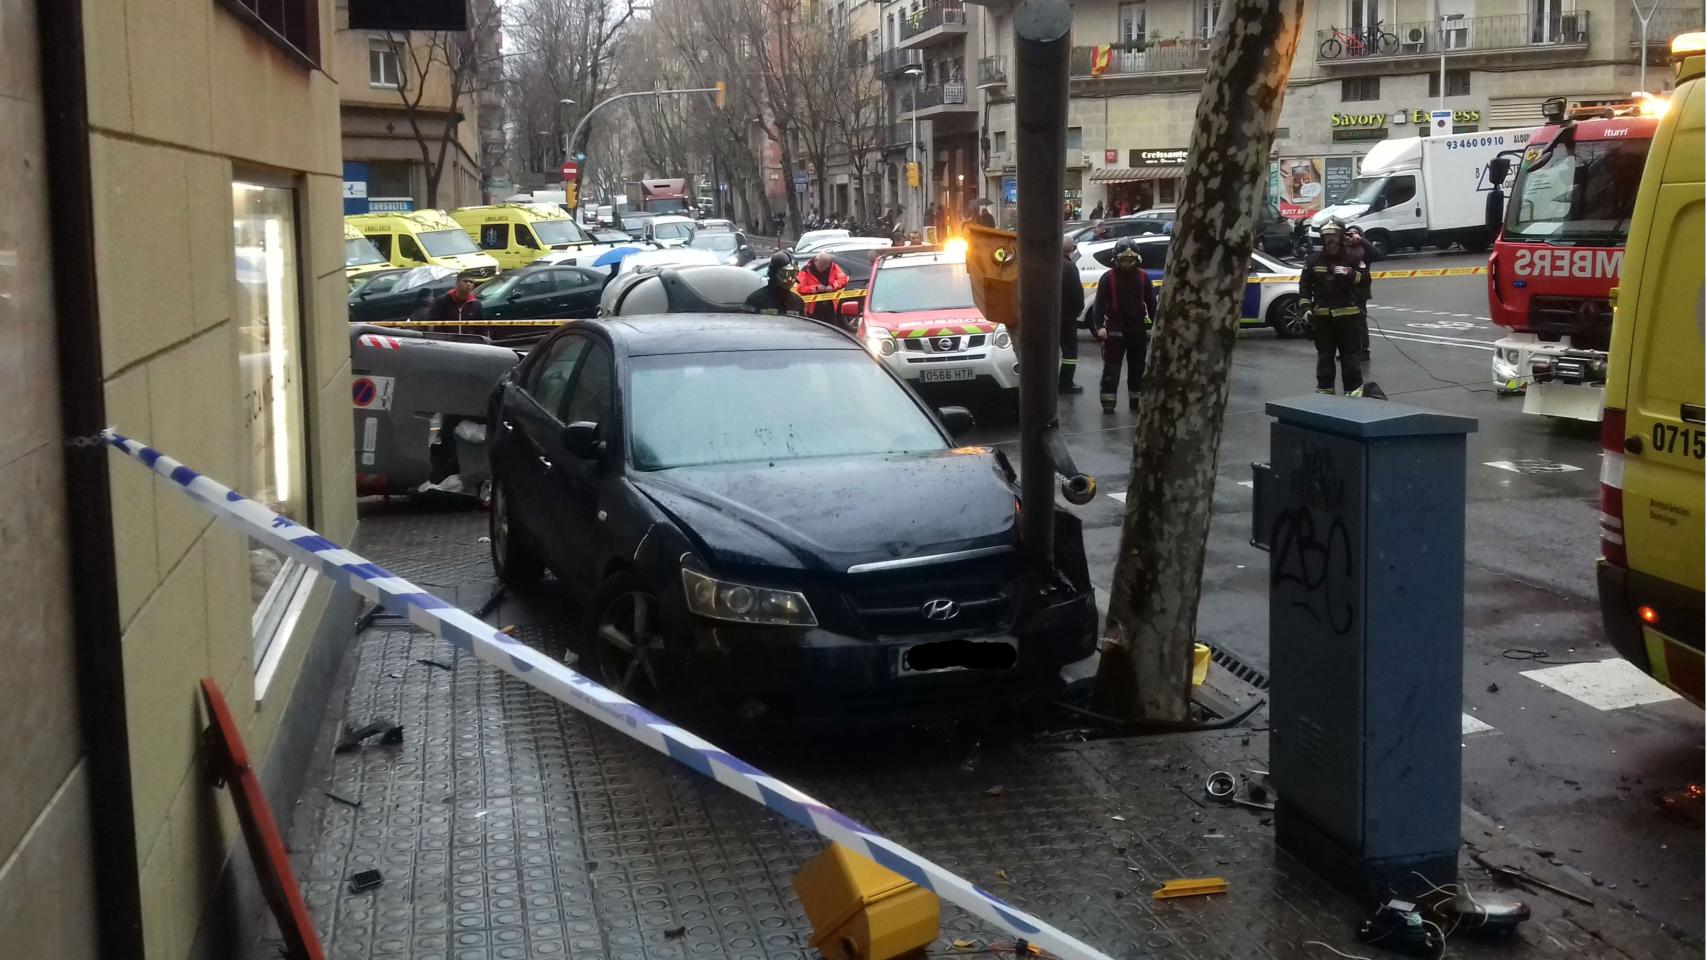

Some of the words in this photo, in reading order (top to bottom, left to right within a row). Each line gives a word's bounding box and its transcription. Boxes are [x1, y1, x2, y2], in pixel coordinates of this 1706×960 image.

[1330, 111, 1386, 128] Savory
[1413, 108, 1480, 124] Exess
[1446, 140, 1458, 150] 93
[1459, 138, 1478, 149] 460
[1480, 137, 1492, 147] 09
[1494, 136, 1504, 146] 10
[926, 371, 951, 380] 0566
[954, 369, 974, 378] HTR
[1652, 422, 1705, 460] 0715
